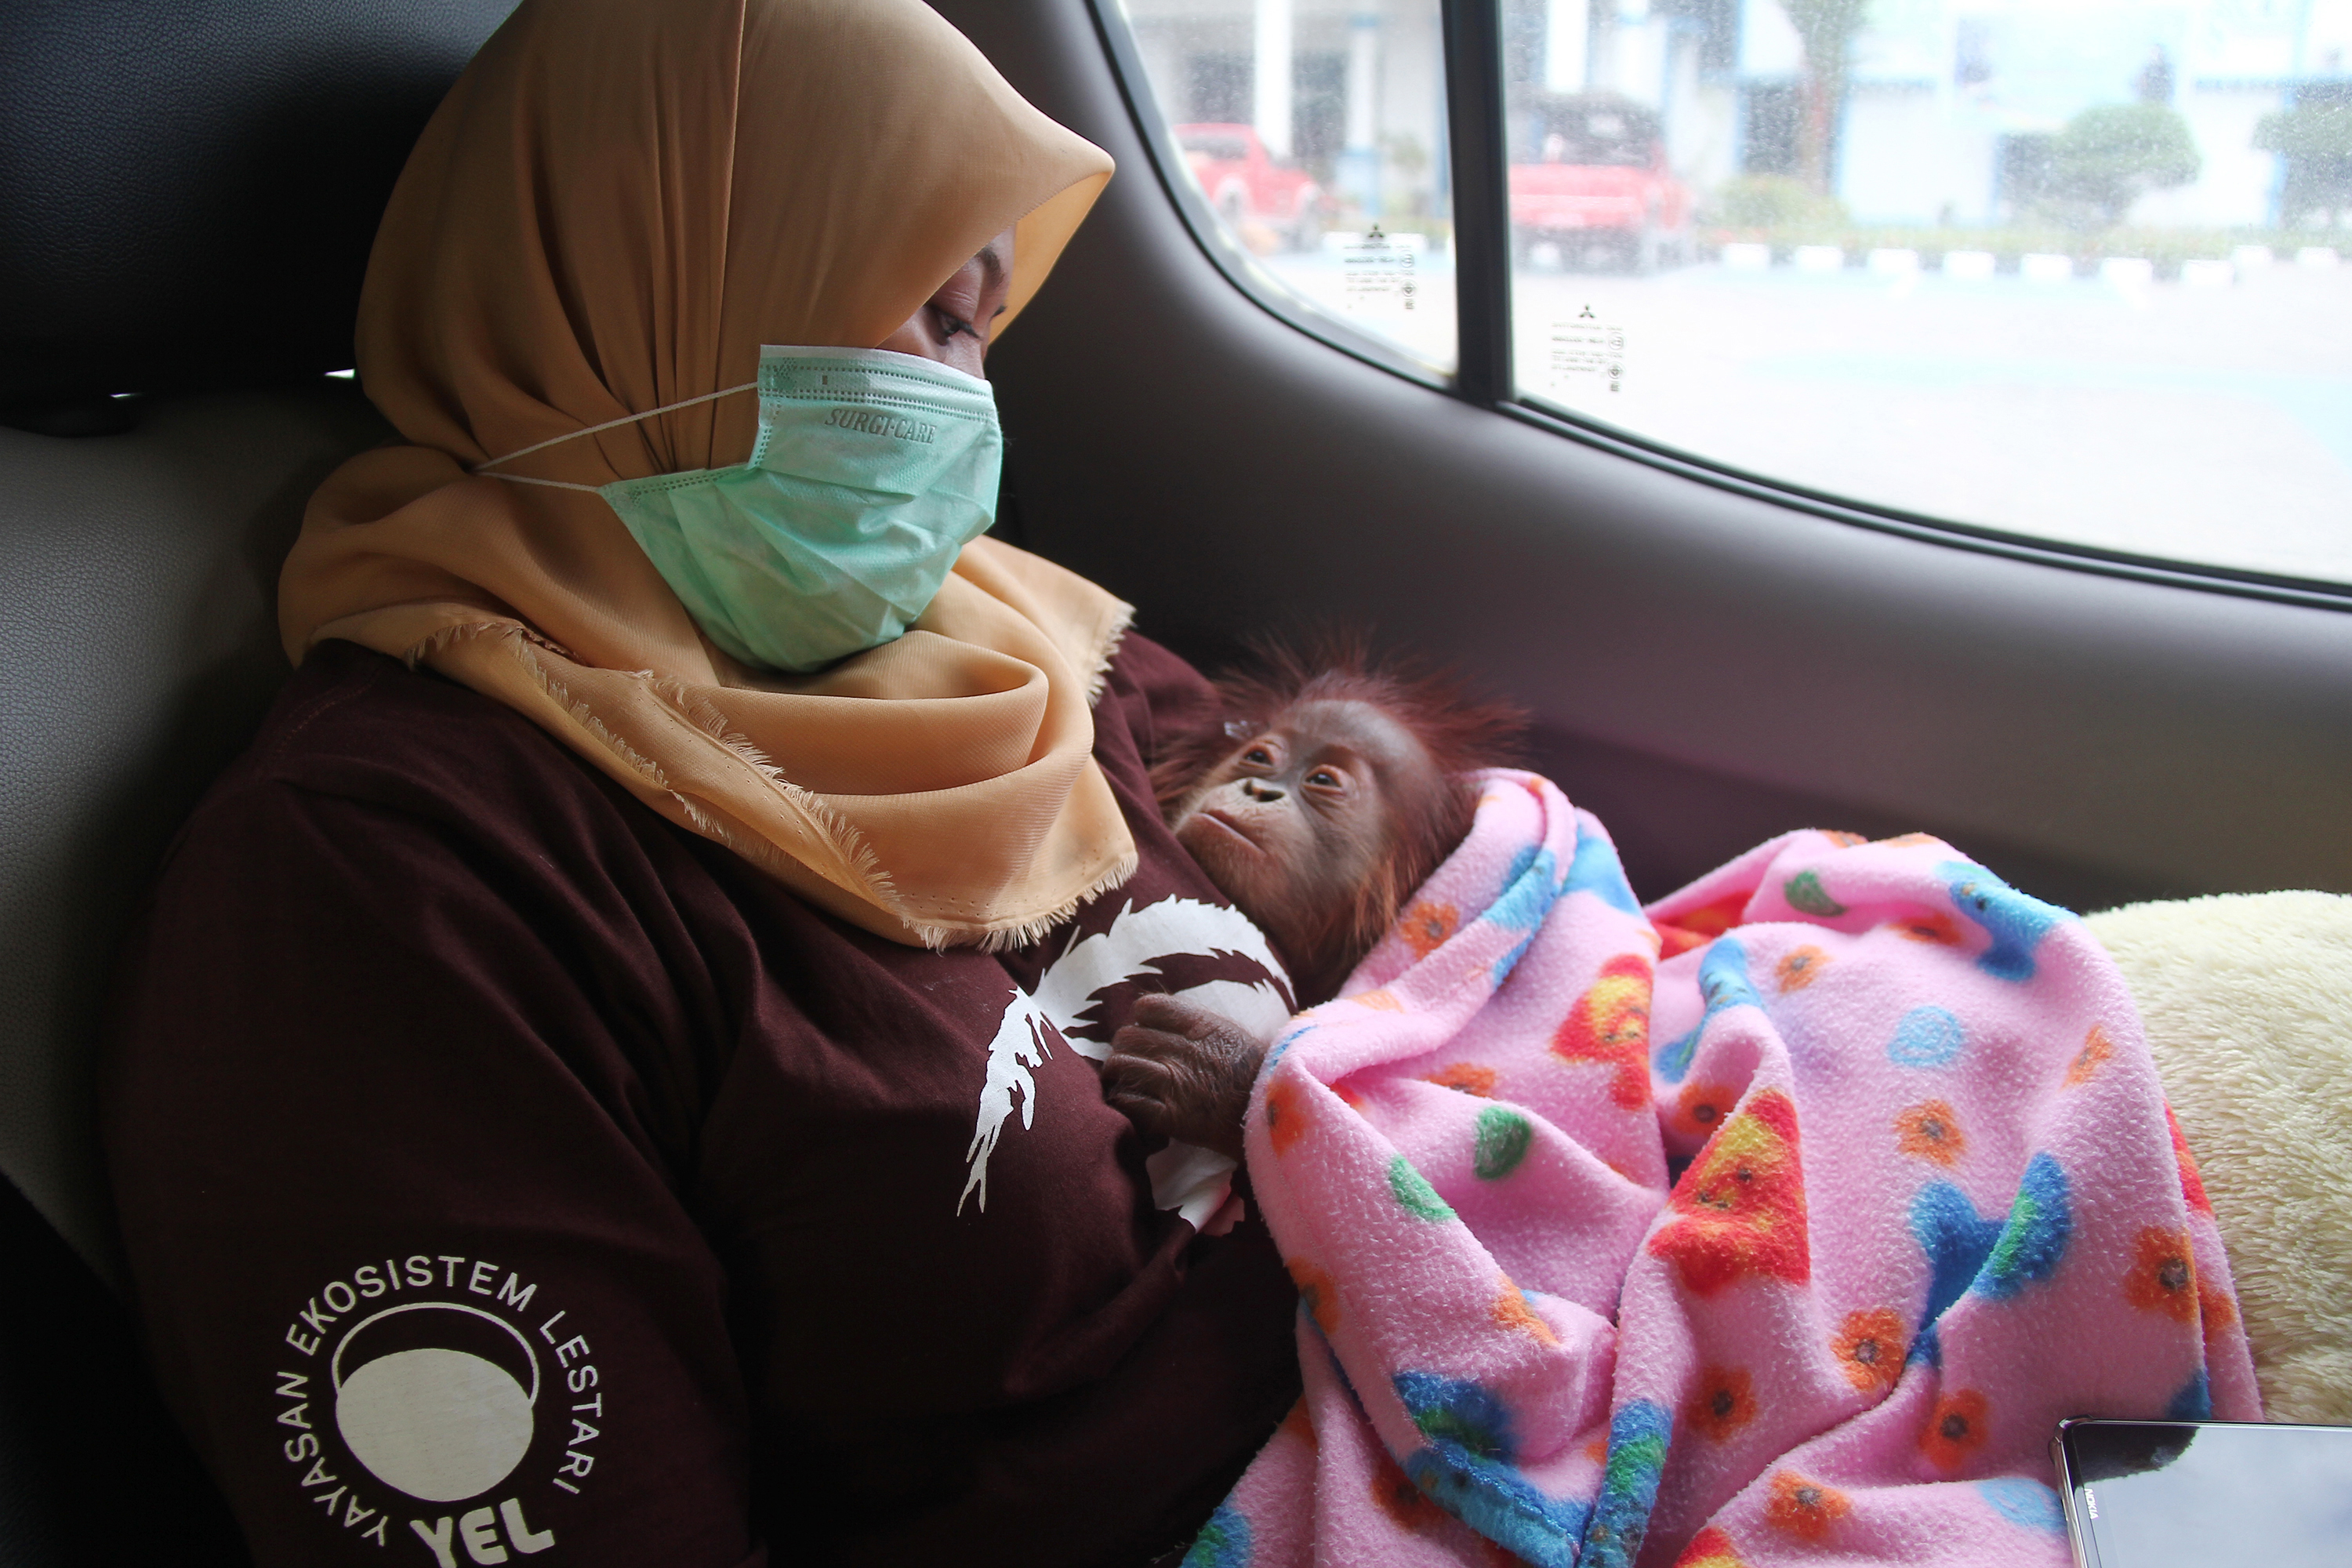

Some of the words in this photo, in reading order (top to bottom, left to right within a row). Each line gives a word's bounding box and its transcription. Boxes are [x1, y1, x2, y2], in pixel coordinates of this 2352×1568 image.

[824, 408, 938, 445] SURGI-CARE
[285, 1254, 538, 1356] EKOSISTEM
[539, 1309, 603, 1494] LESTARI
[275, 1371, 389, 1547] YAYASAN
[408, 1497, 556, 1568] YEL
[2084, 1488, 2099, 1519] NOKIA
